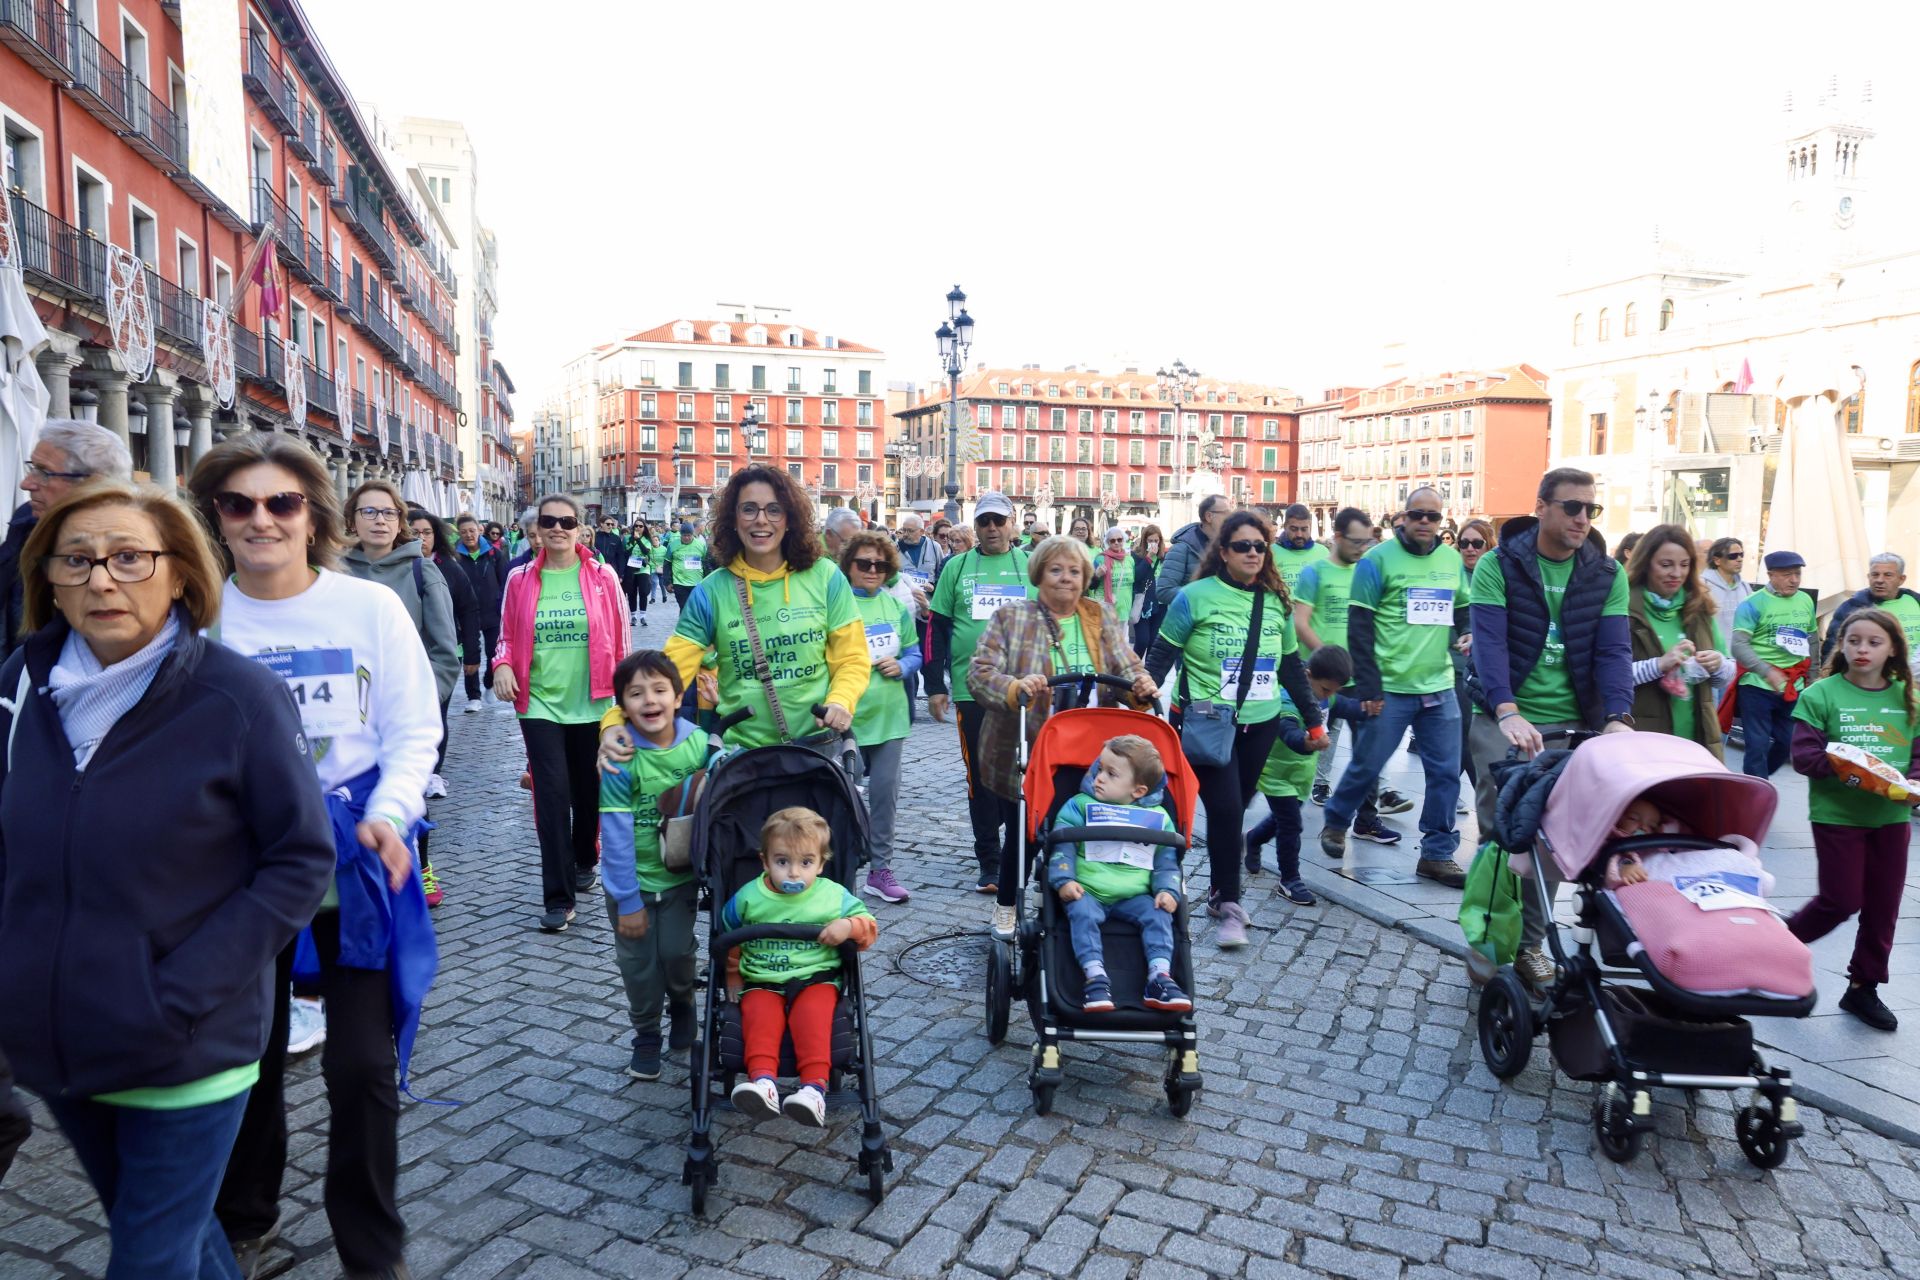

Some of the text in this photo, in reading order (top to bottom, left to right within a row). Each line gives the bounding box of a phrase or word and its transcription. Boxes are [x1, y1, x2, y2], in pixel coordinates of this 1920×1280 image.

[765, 627, 824, 649] marcha
[742, 650, 797, 670] cntra
[769, 664, 818, 681] áncer
[1840, 713, 1855, 722] En
[1840, 722, 1884, 732] marcha
[1841, 733, 1879, 742] contra
[641, 793, 656, 804] En
